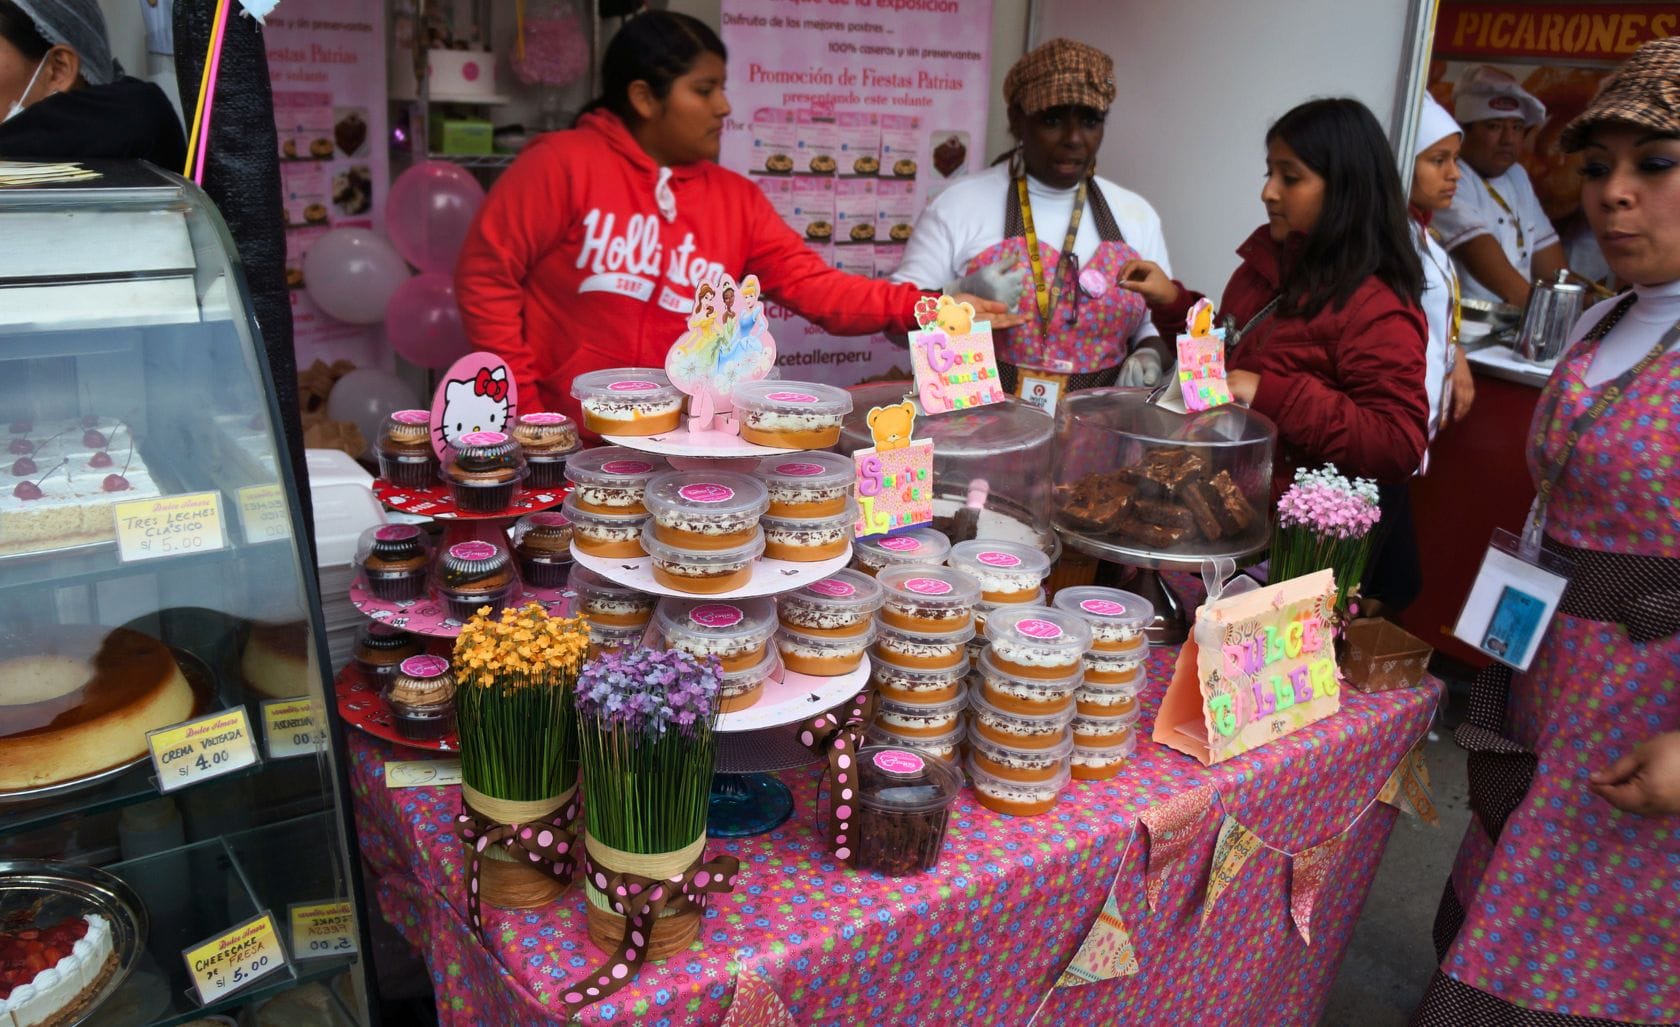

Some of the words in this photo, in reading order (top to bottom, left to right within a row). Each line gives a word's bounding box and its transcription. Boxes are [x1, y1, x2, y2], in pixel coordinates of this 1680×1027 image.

[769, 17, 782, 28] de
[1452, 12, 1677, 54] PICARONES
[828, 42, 856, 53] 100%
[749, 63, 833, 85] Promoción
[838, 67, 856, 86] de
[862, 67, 912, 88] Fiestas
[917, 70, 963, 90] Patrias
[783, 91, 860, 106] presentando
[863, 95, 888, 105] este
[892, 93, 934, 107] volante
[774, 348, 872, 367] lcetallerperu
[123, 514, 158, 530] TRES
[167, 508, 216, 524] LECHES
[162, 536, 202, 553] 5.00
[161, 743, 194, 764] CREMA
[194, 750, 230, 771] 4.00
[195, 936, 257, 973] CHEESCAKE
[229, 941, 265, 968] FRESA
[232, 956, 268, 984] 5.00
